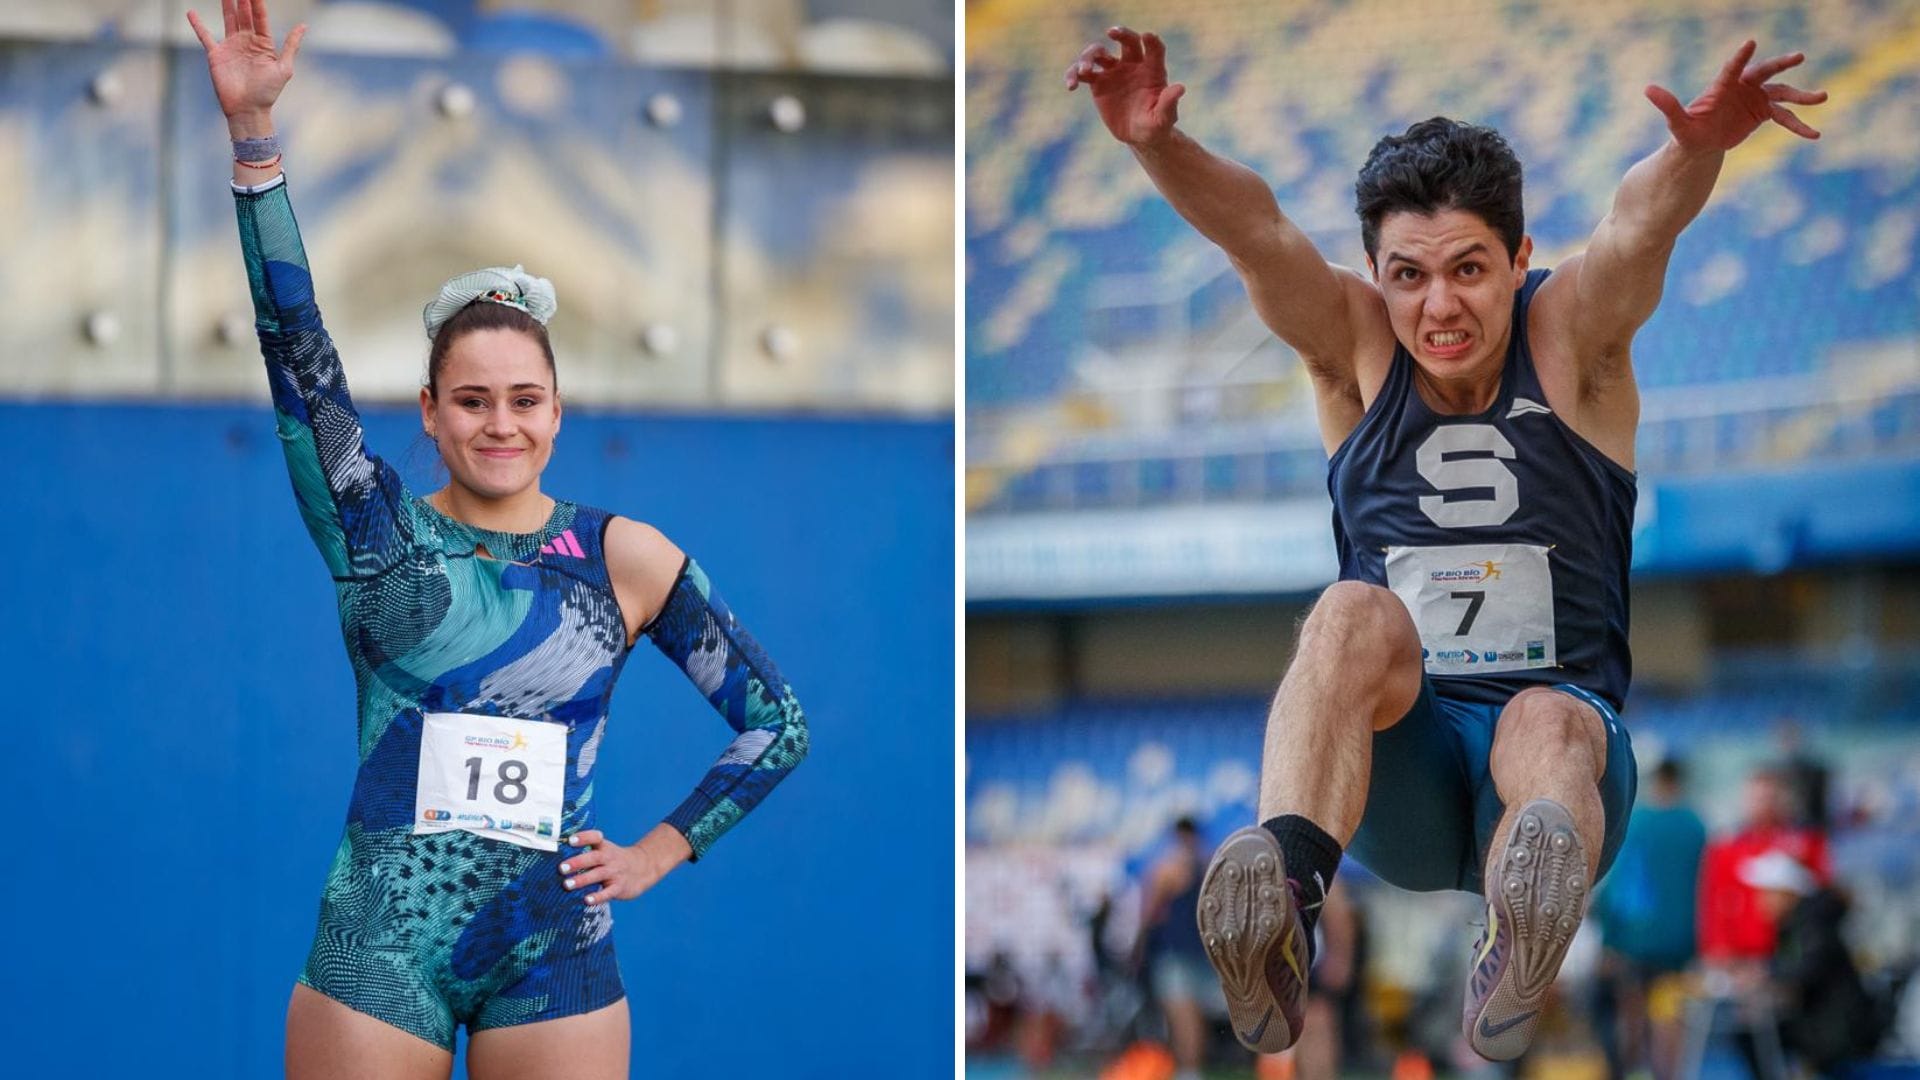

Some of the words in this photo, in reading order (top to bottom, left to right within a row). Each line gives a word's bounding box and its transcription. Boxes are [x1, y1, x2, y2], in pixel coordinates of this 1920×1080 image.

[1416, 424, 1520, 528] S
[1450, 590, 1486, 636] 7
[465, 756, 529, 806] 18
